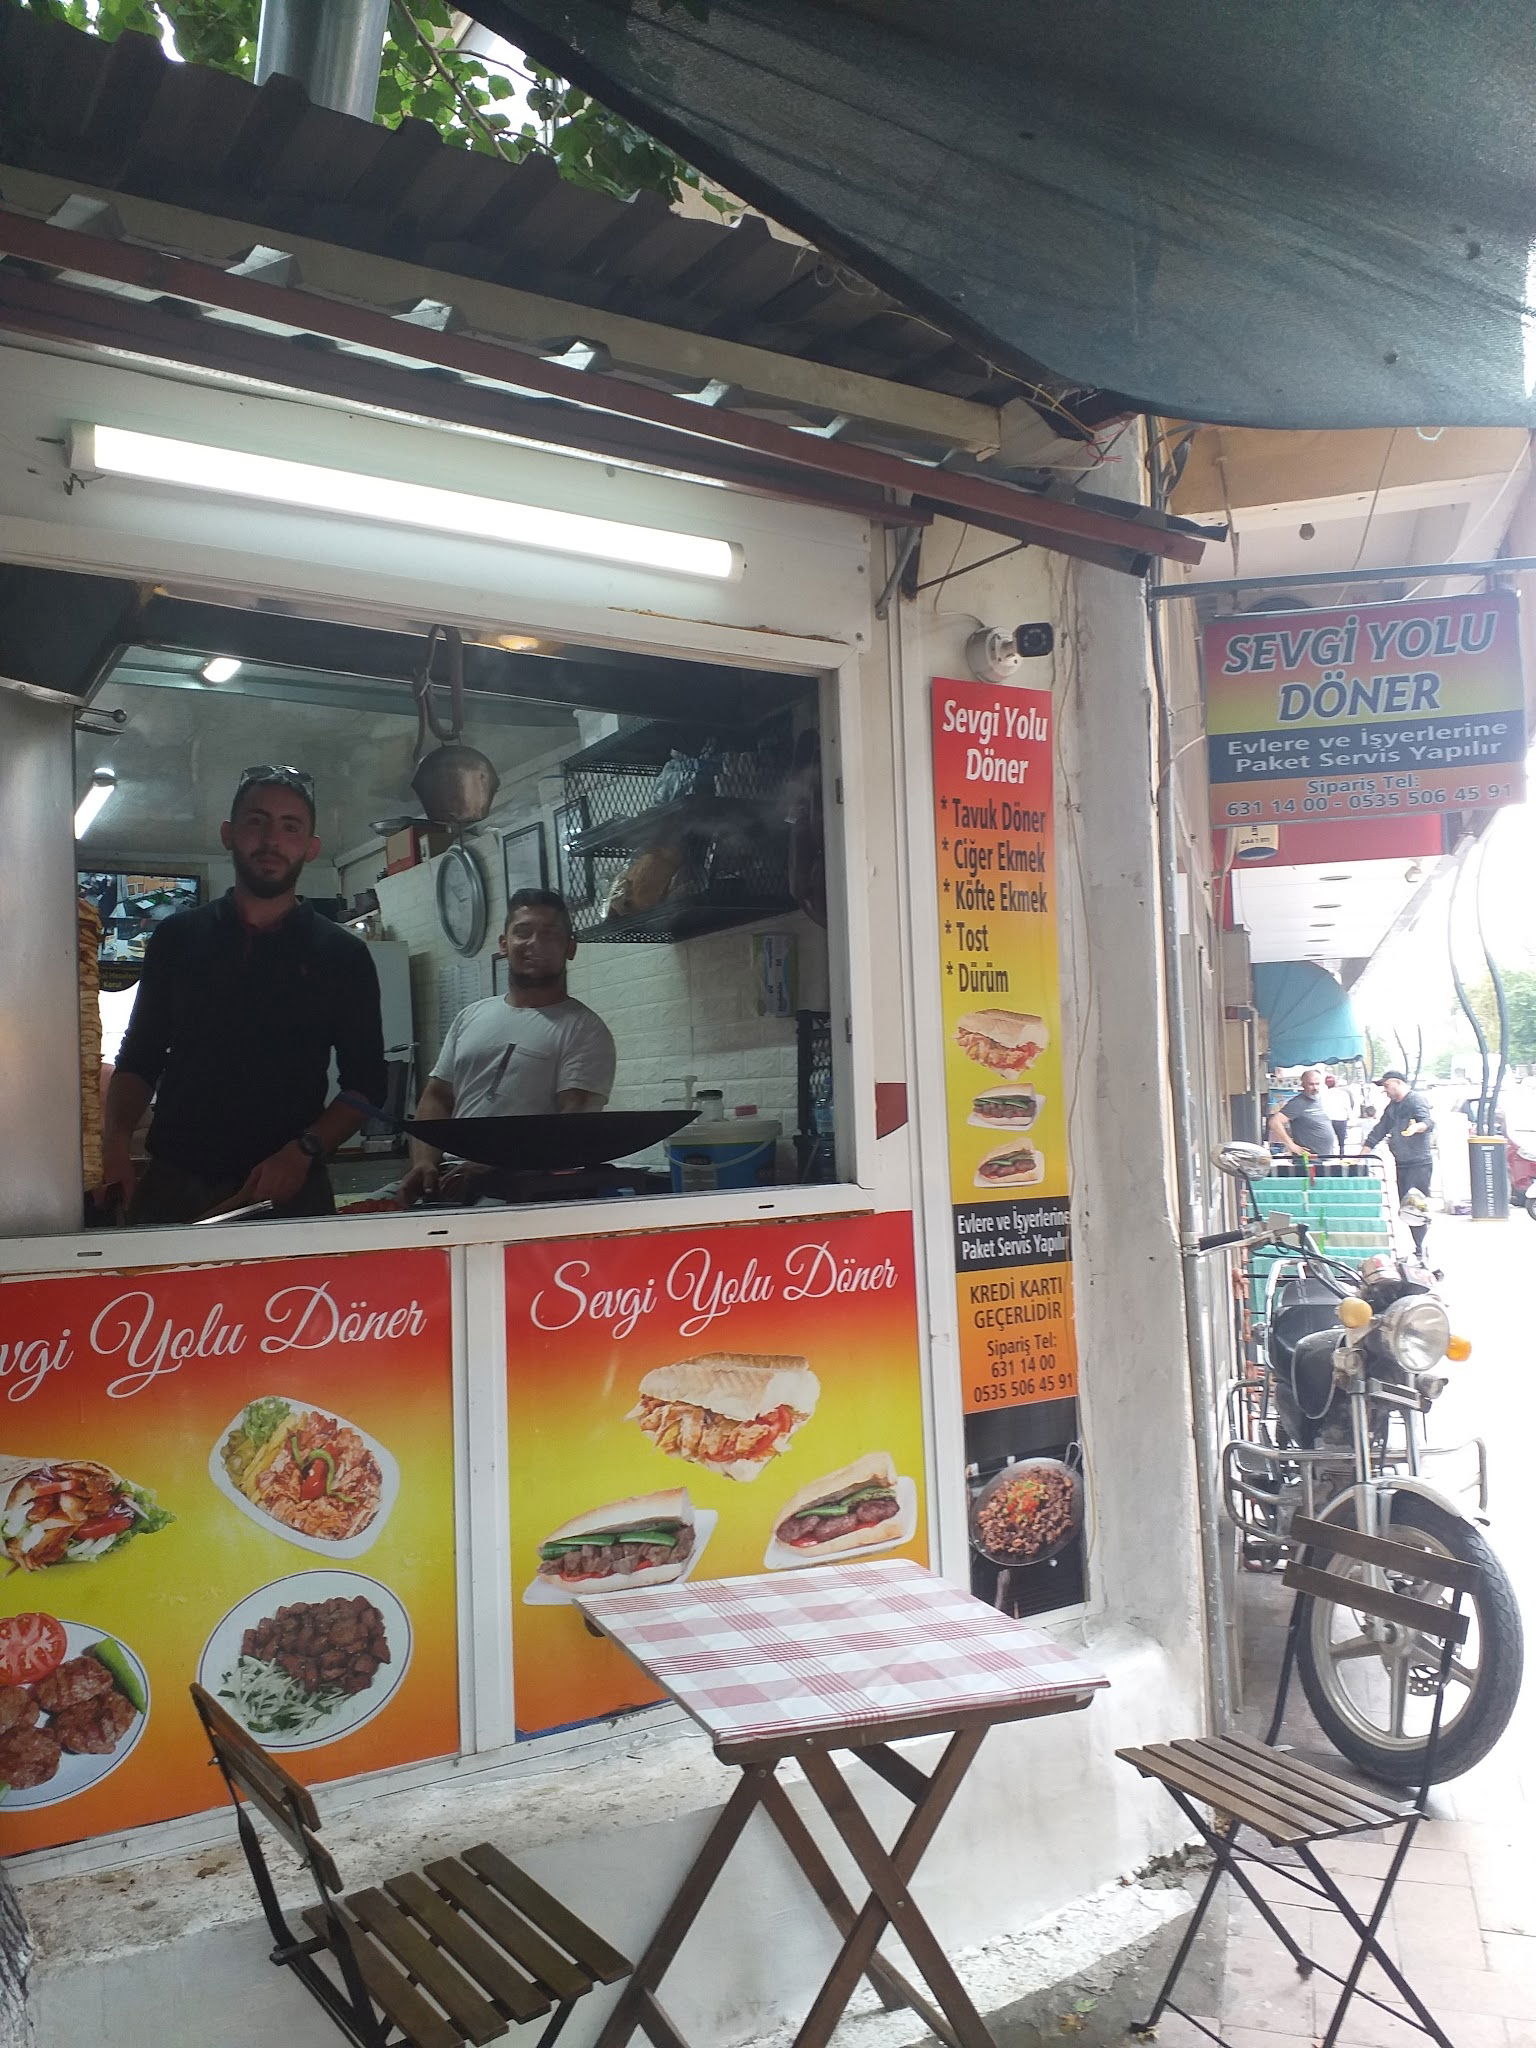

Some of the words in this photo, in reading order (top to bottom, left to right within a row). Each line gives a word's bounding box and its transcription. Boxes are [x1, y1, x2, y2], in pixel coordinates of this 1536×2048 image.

[1223, 616, 1358, 675] SEVGİ
[1369, 611, 1498, 661] YOLU
[1278, 671, 1441, 722] DÖNER
[942, 699, 1000, 744] Sevgi
[1003, 706, 1049, 742] Yolu
[1228, 738, 1310, 756] Evlere
[1319, 736, 1350, 749] ve
[1236, 755, 1311, 773] Paket
[1319, 745, 1400, 767] Servis
[1409, 741, 1502, 762] Yapılır
[965, 748, 1029, 784] Döner
[1227, 801, 1263, 816] 631
[1272, 799, 1296, 813] 14
[1303, 797, 1328, 812] 00
[1350, 793, 1400, 809] 0535
[1408, 789, 1446, 805] 506
[1454, 786, 1480, 801] 45
[1488, 784, 1512, 799] 91
[1307, 778, 1376, 797] Sipariş
[1383, 774, 1420, 790] Tel:
[952, 798, 998, 830] Tavuk
[1002, 801, 1046, 833] Döner
[954, 838, 993, 877] Ciğer
[998, 840, 1046, 873] Ekmek
[955, 879, 995, 912] Köfte
[999, 880, 1048, 913] Ekmek
[956, 921, 989, 952] Tost
[958, 962, 1009, 993] Dürüm
[957, 1212, 994, 1234] Evlere
[996, 1215, 1011, 1231] ve
[962, 1238, 996, 1260] Paket
[997, 1234, 1032, 1257] Servis
[530, 1259, 658, 1340] Sevgi
[665, 1247, 774, 1337] Yolu
[782, 1240, 899, 1301] Döner
[970, 1276, 1015, 1304] KREDİ
[1020, 1276, 1063, 1298] KARTI
[974, 1297, 1063, 1331] GEÇERLİDİR
[0, 1328, 75, 1402] vgi
[89, 1290, 249, 1399] Yolu
[259, 1280, 428, 1354] Döner
[986, 1336, 1030, 1360] Sipariş
[1036, 1331, 1057, 1350] Tel:
[991, 1360, 1015, 1378] 631
[1020, 1357, 1036, 1374] 14
[1039, 1353, 1056, 1370] 00
[973, 1383, 1008, 1403] 0535
[1011, 1379, 1036, 1397] 506
[1039, 1375, 1055, 1393] 45
[1059, 1372, 1074, 1390] 91
